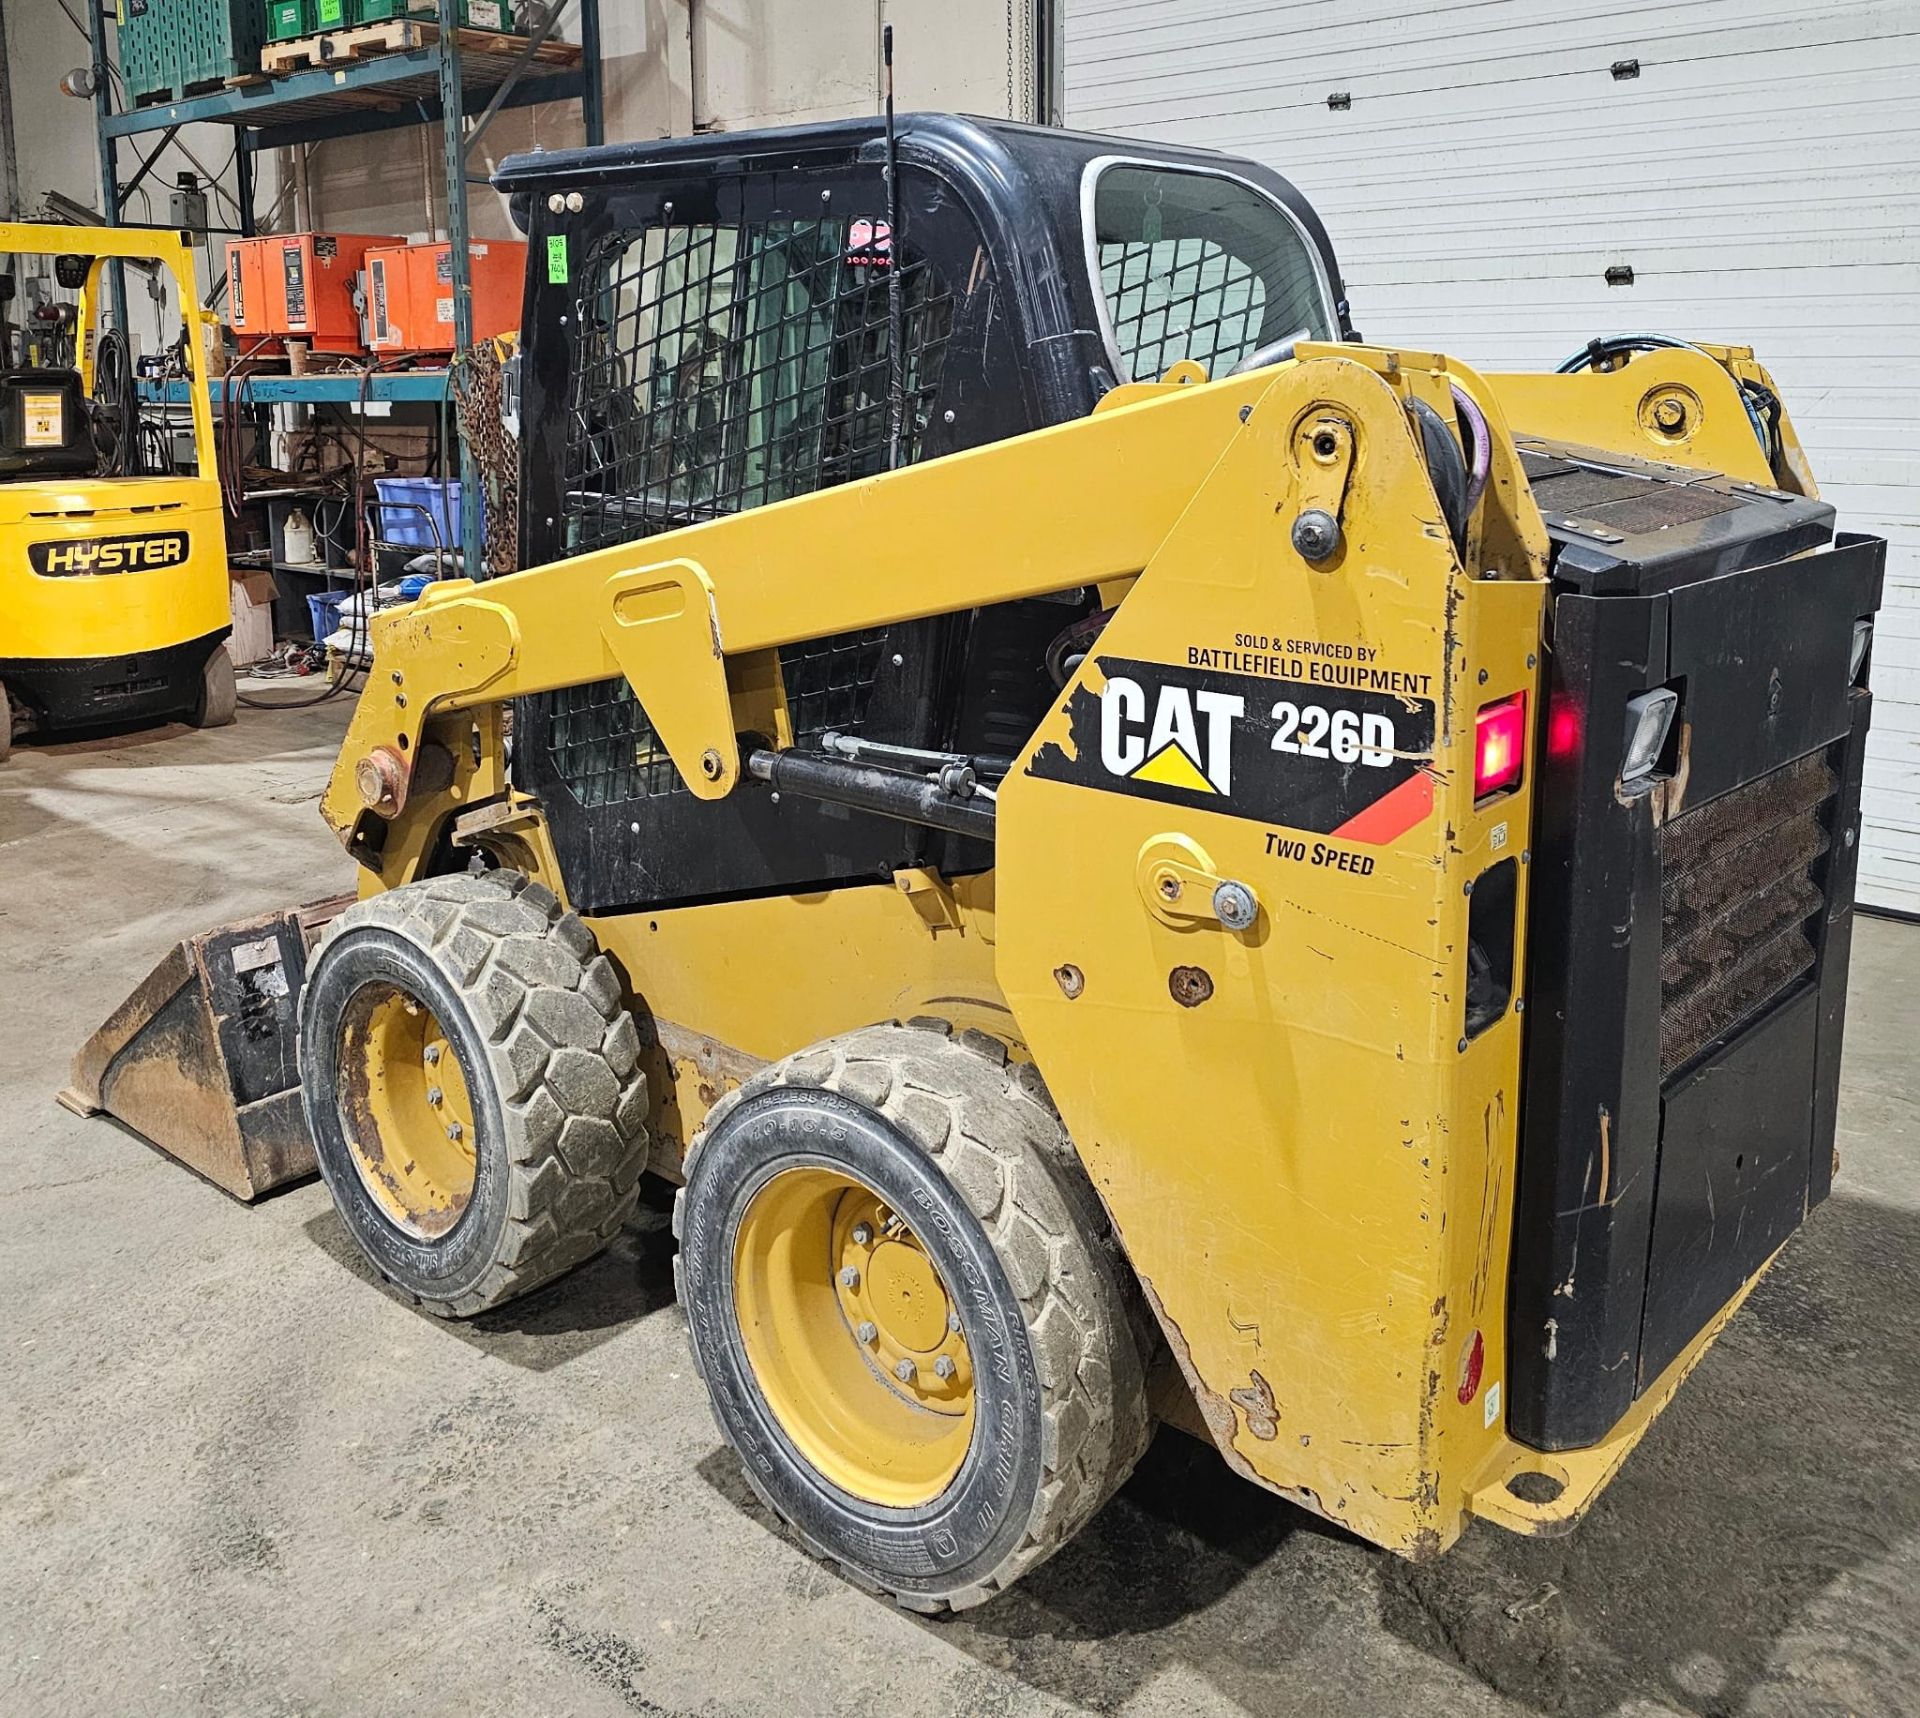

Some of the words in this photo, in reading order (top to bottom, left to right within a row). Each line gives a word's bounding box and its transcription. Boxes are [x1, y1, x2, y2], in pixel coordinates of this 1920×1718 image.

[47, 538, 181, 572] HYSTER
[1235, 633, 1268, 650] SOLD
[1272, 637, 1282, 652] &
[1287, 639, 1353, 660] SERVICED
[1357, 647, 1377, 662] BY
[1188, 647, 1303, 678] BATTLEFIELD
[1310, 662, 1432, 694] EQUIPMENT
[1101, 677, 1245, 796] CAT
[1270, 701, 1396, 768] 226D
